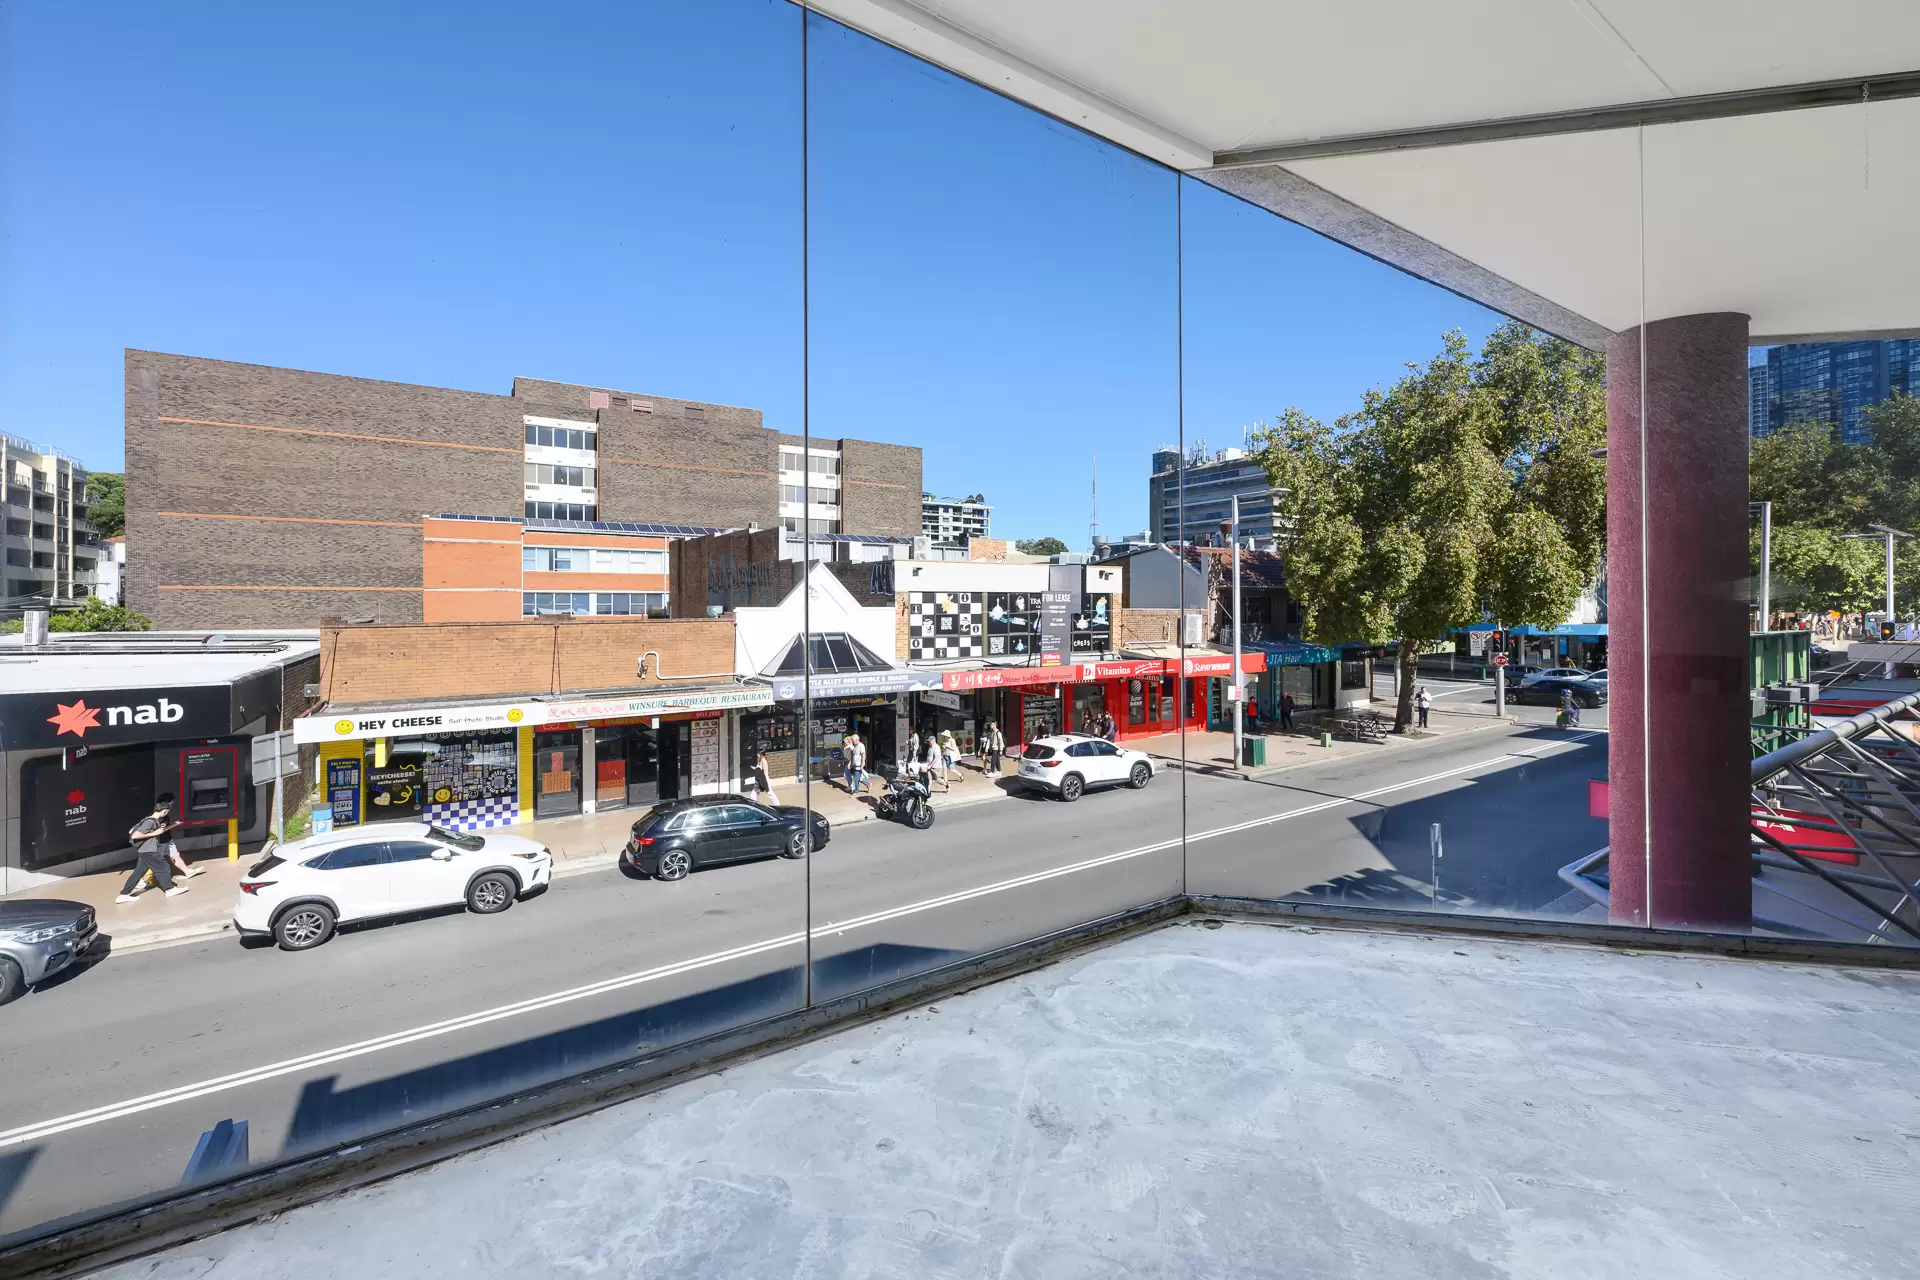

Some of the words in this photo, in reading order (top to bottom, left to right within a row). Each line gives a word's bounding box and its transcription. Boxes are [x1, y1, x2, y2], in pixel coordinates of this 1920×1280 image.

[1042, 594, 1054, 602] FOR
[1055, 593, 1071, 602] LEASE
[1269, 654, 1283, 664] JIA
[1285, 653, 1301, 663] Hair
[1097, 666, 1131, 676] Vitamins
[858, 676, 881, 684] NOODLE
[629, 701, 668, 711] WINSURE
[672, 697, 717, 706] BARBEQUE
[721, 692, 771, 703] RESTAURANT
[106, 698, 184, 726] nab
[359, 720, 386, 730] HEY
[392, 716, 442, 728] CHEESE
[75, 745, 88, 759] nab
[64, 804, 87, 816] nab
